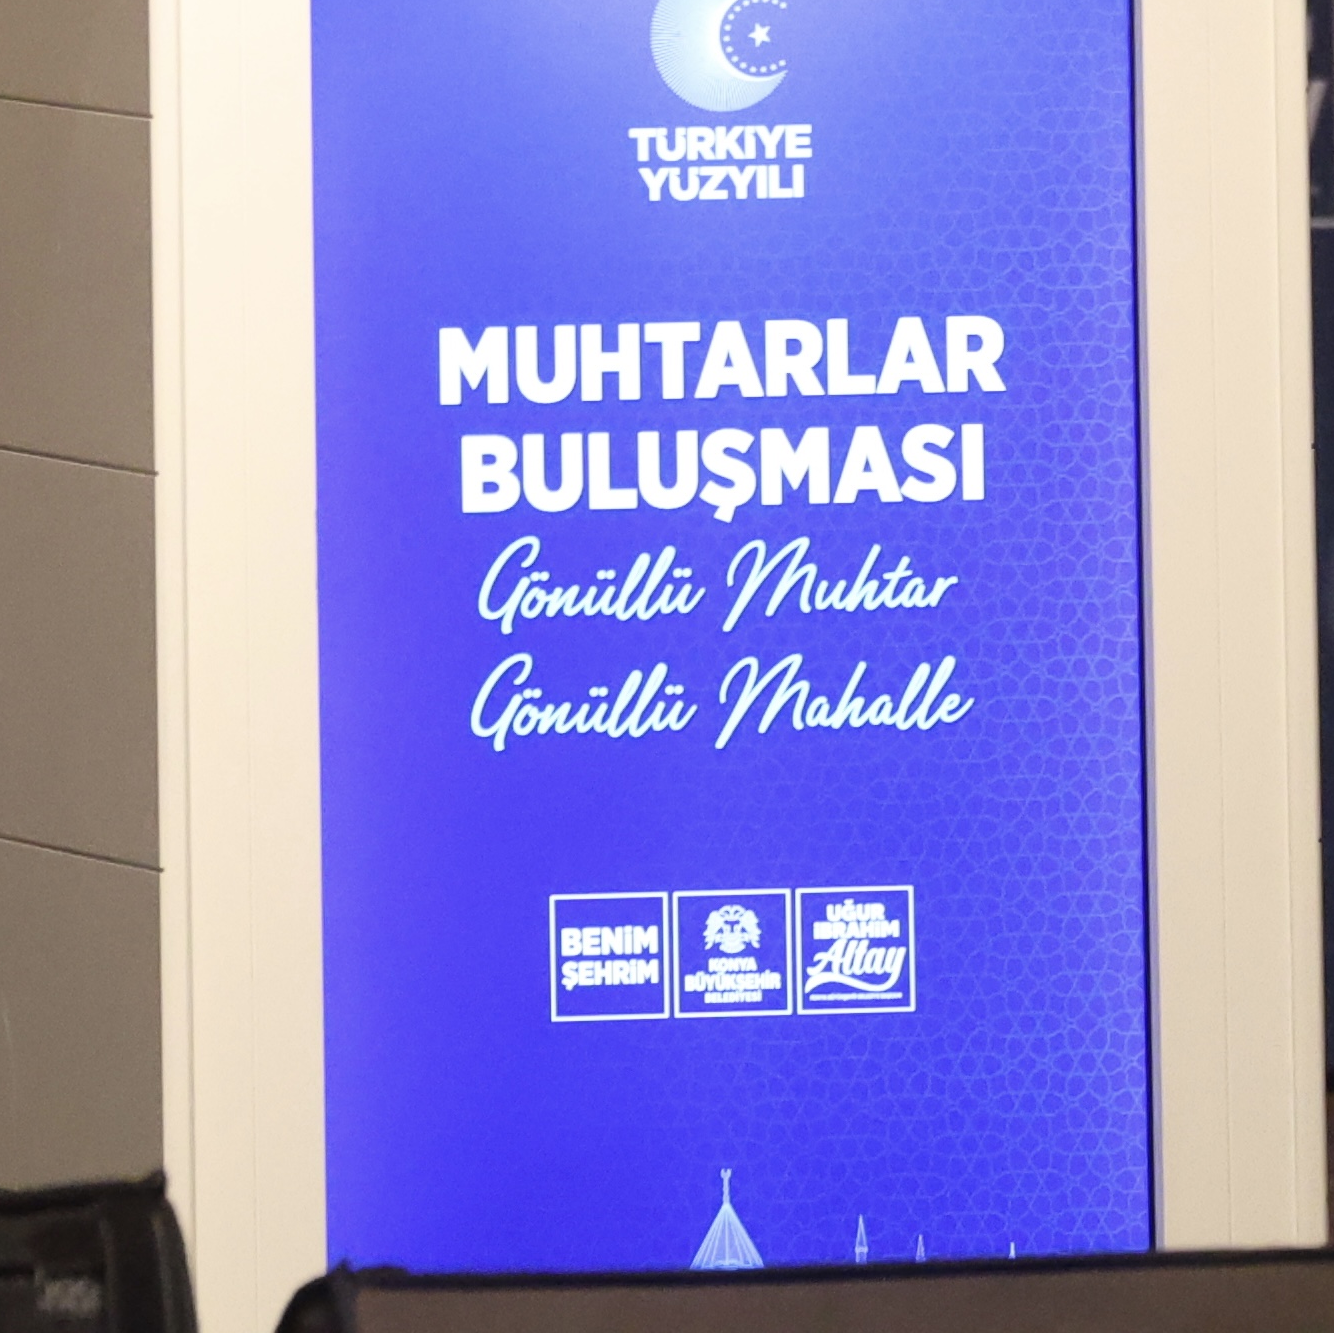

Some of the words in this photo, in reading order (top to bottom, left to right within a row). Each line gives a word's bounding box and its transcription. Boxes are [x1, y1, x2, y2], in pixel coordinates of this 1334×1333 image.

[439, 315, 1006, 405] MUHTARLAR
[461, 423, 984, 522] BULUŞMASI
[478, 536, 705, 634] Gönüllü
[723, 537, 958, 632] Muhtar
[471, 653, 697, 751] Gönüllü
[715, 654, 974, 749] Mahalle
[826, 898, 886, 921] UĞUR
[708, 957, 758, 972] KONYA
[804, 938, 907, 993] Altay
